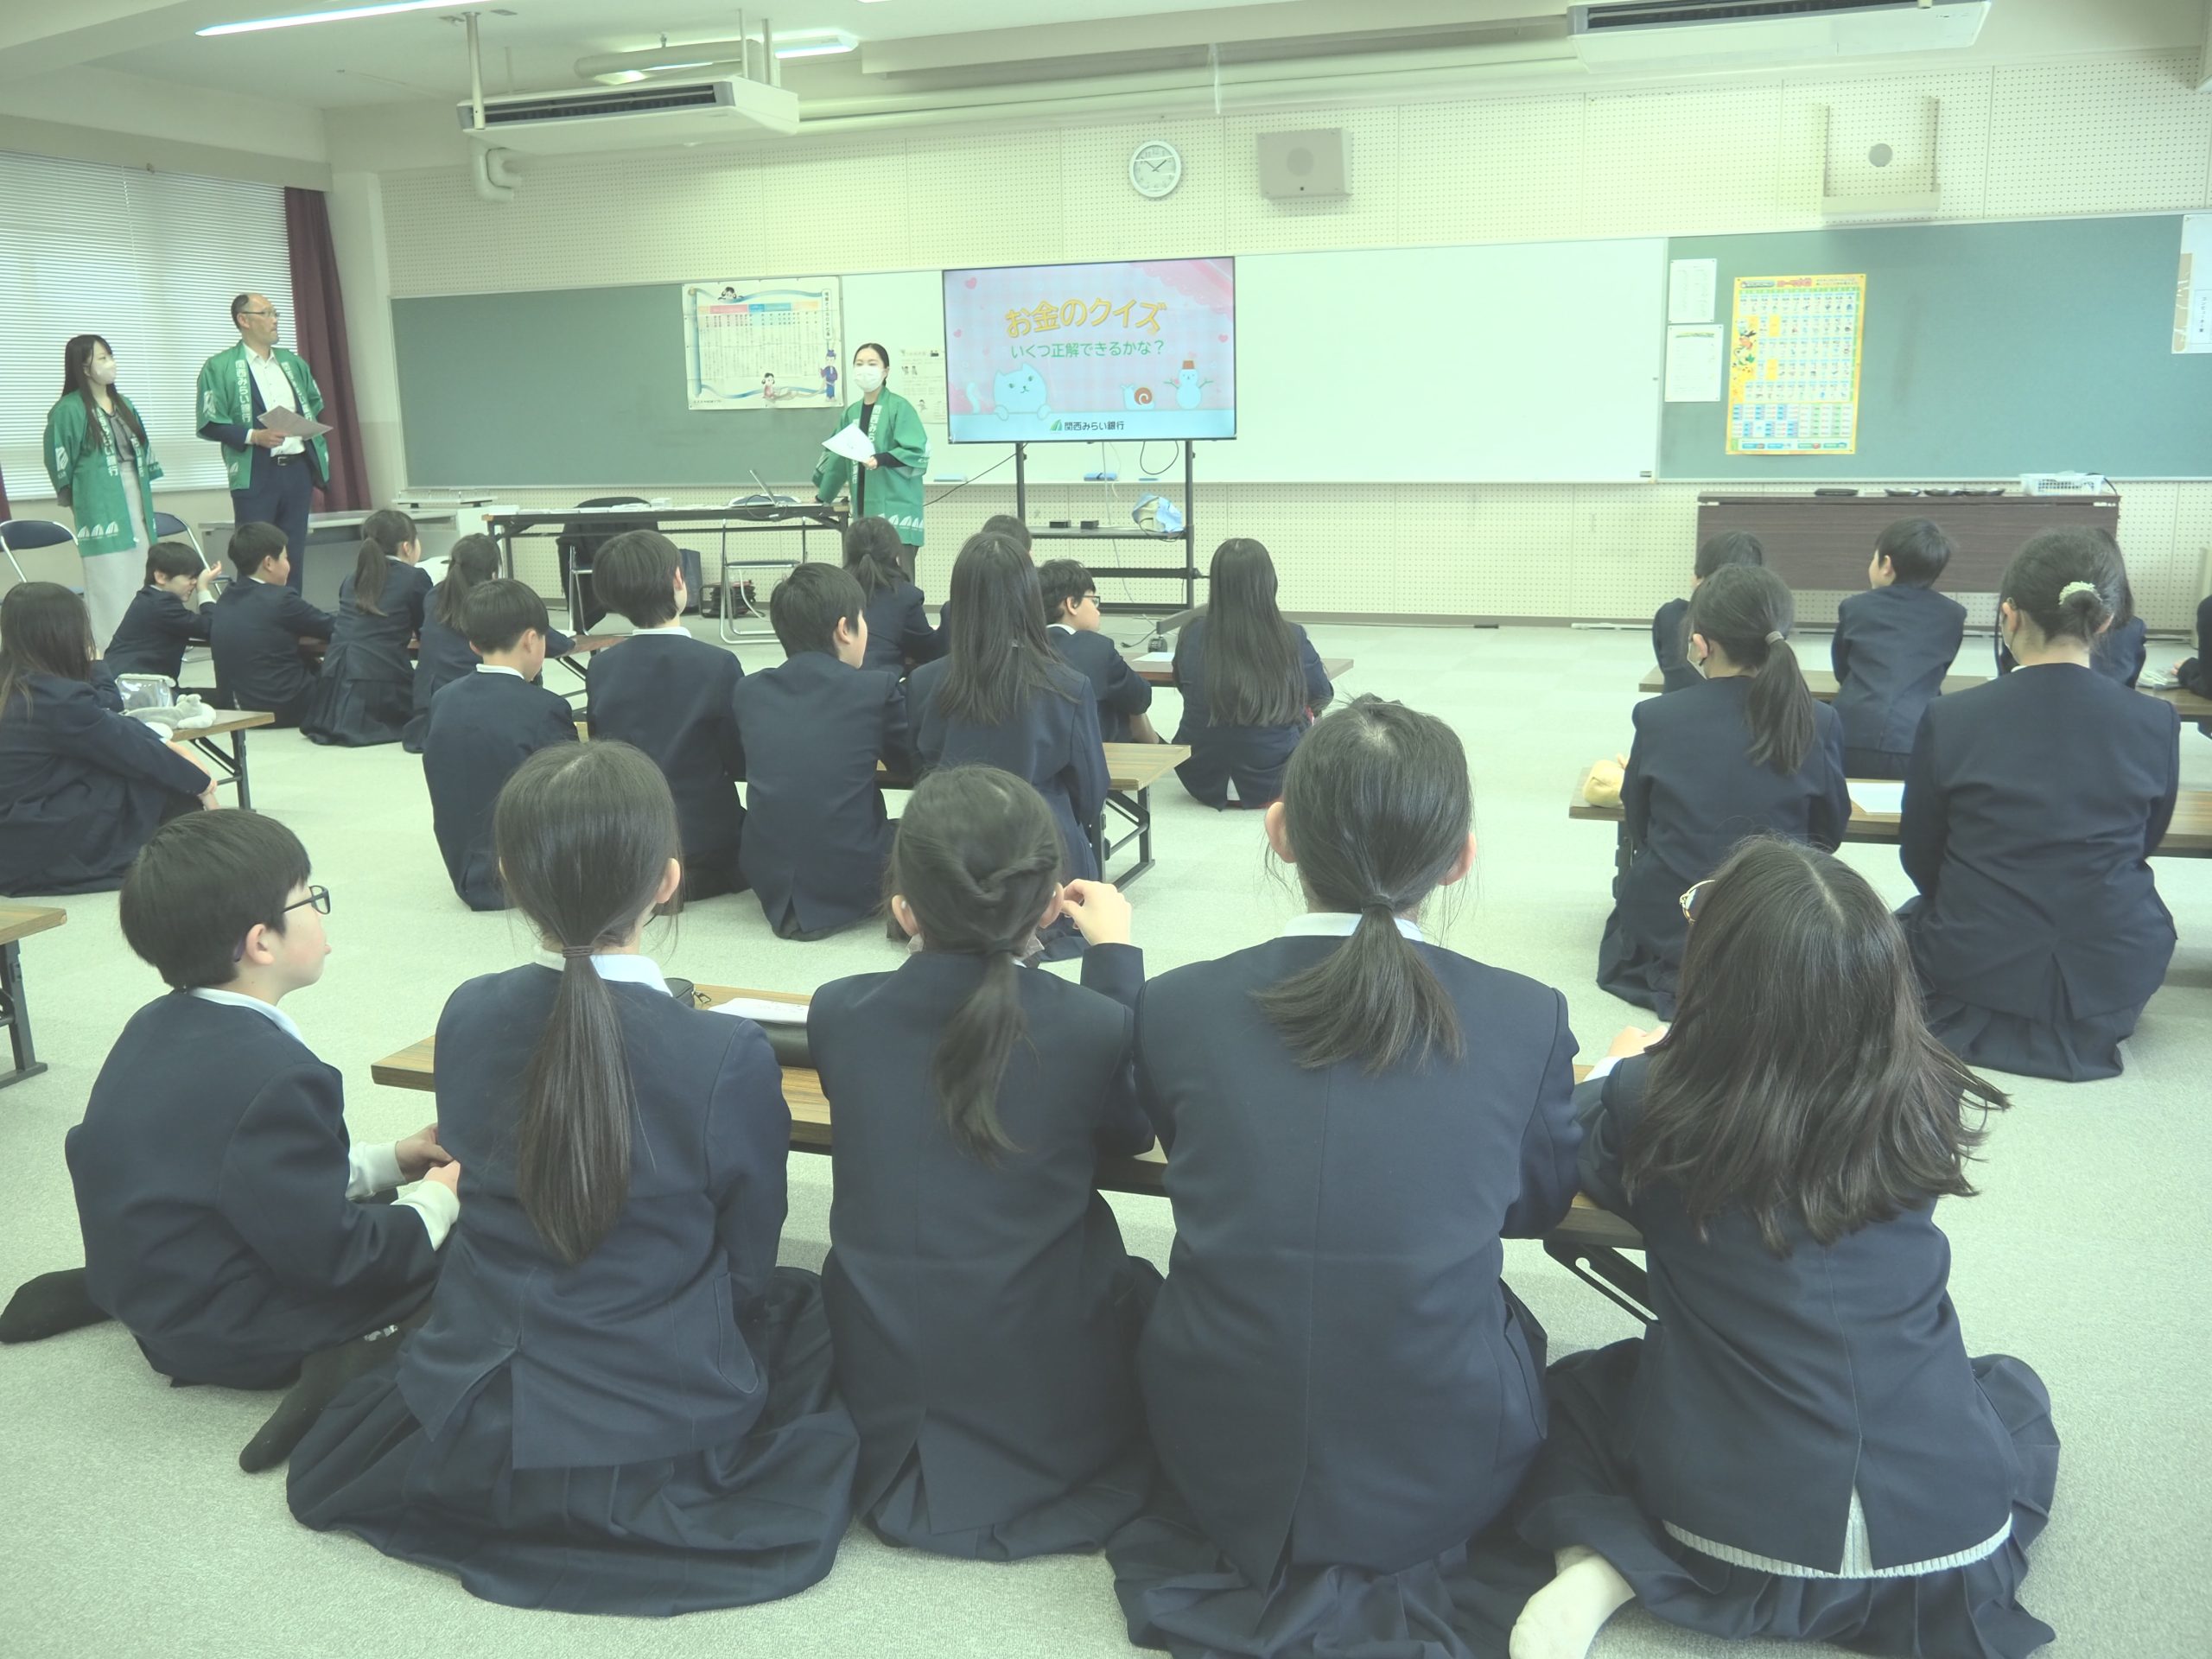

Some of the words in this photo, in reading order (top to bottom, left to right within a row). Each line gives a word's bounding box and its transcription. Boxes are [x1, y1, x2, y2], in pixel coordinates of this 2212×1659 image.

[1005, 297, 1167, 338] お金のクイズ
[1010, 340, 1164, 359] いくつ正解できるかな？
[1064, 421, 1125, 431] 関西みらい銀行
